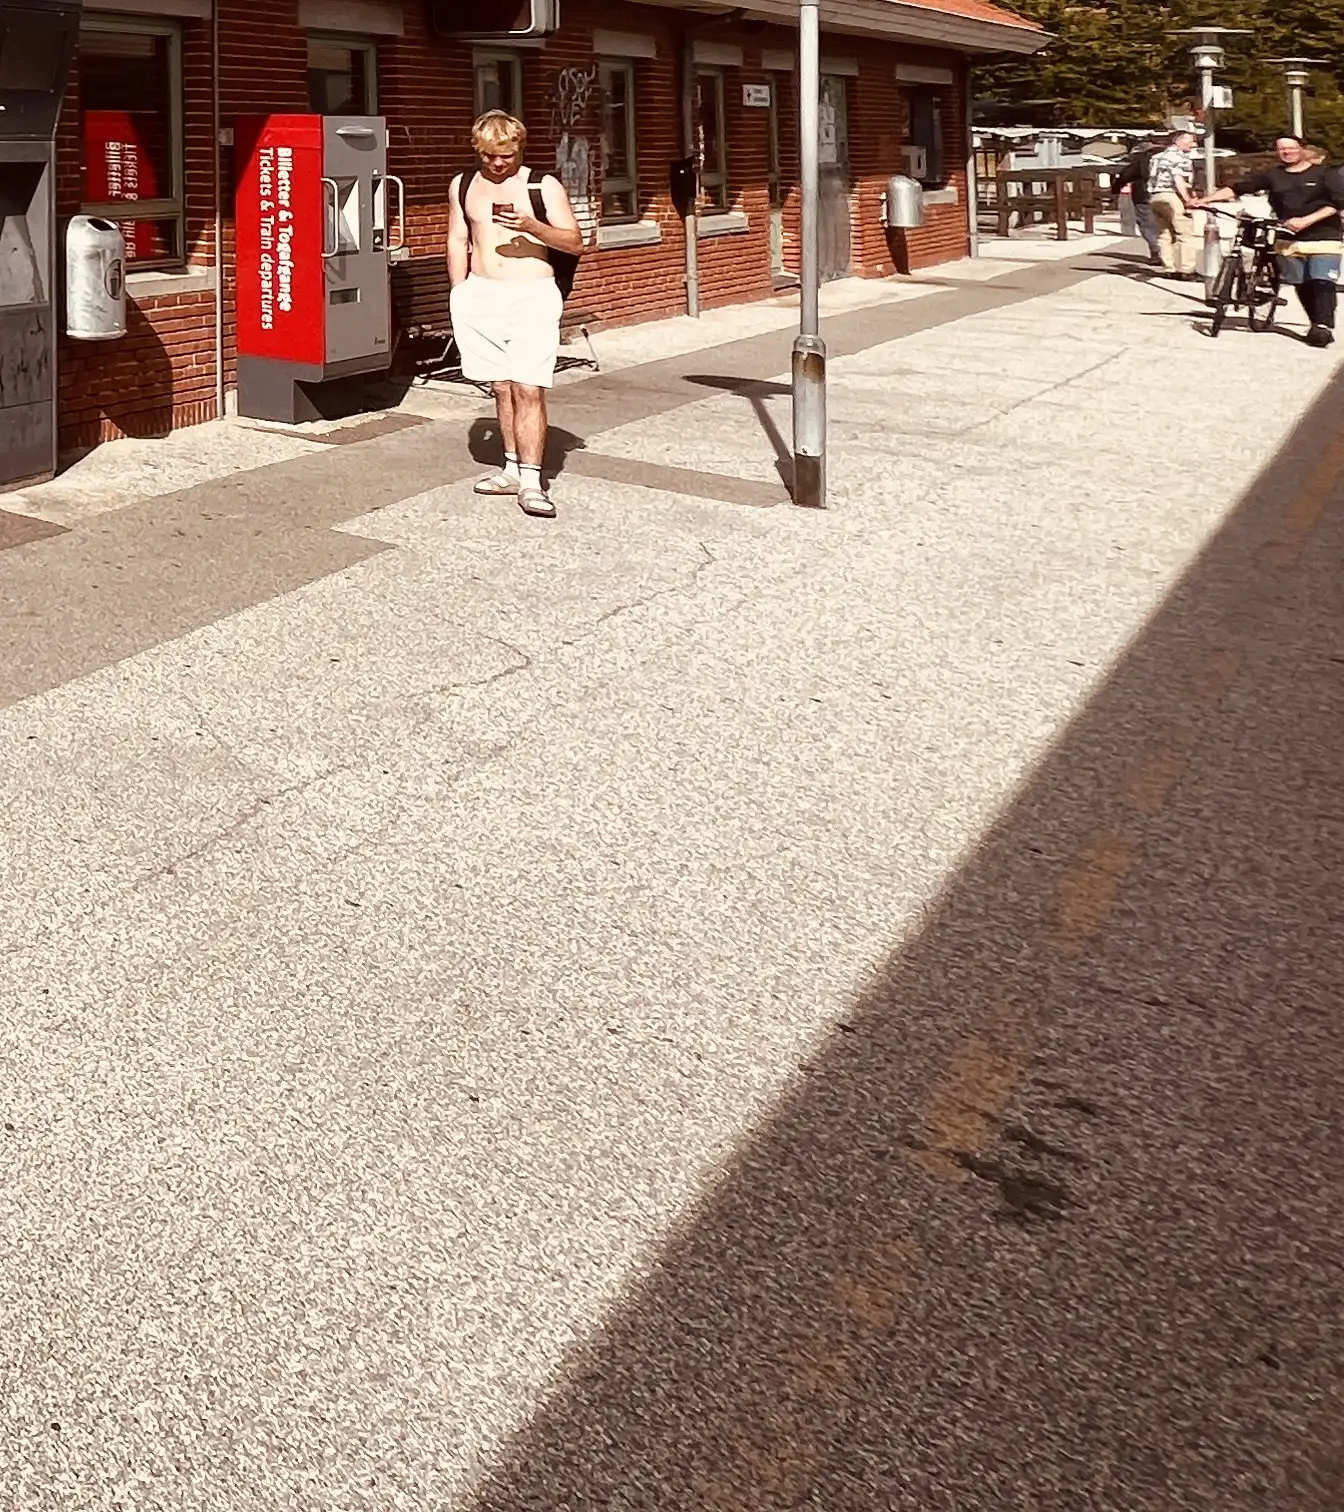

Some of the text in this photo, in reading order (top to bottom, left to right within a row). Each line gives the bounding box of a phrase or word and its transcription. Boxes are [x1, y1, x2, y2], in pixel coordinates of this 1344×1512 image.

[258, 147, 275, 329] Tickets & Train departures
[276, 147, 295, 312] Billetter & Togafgange
